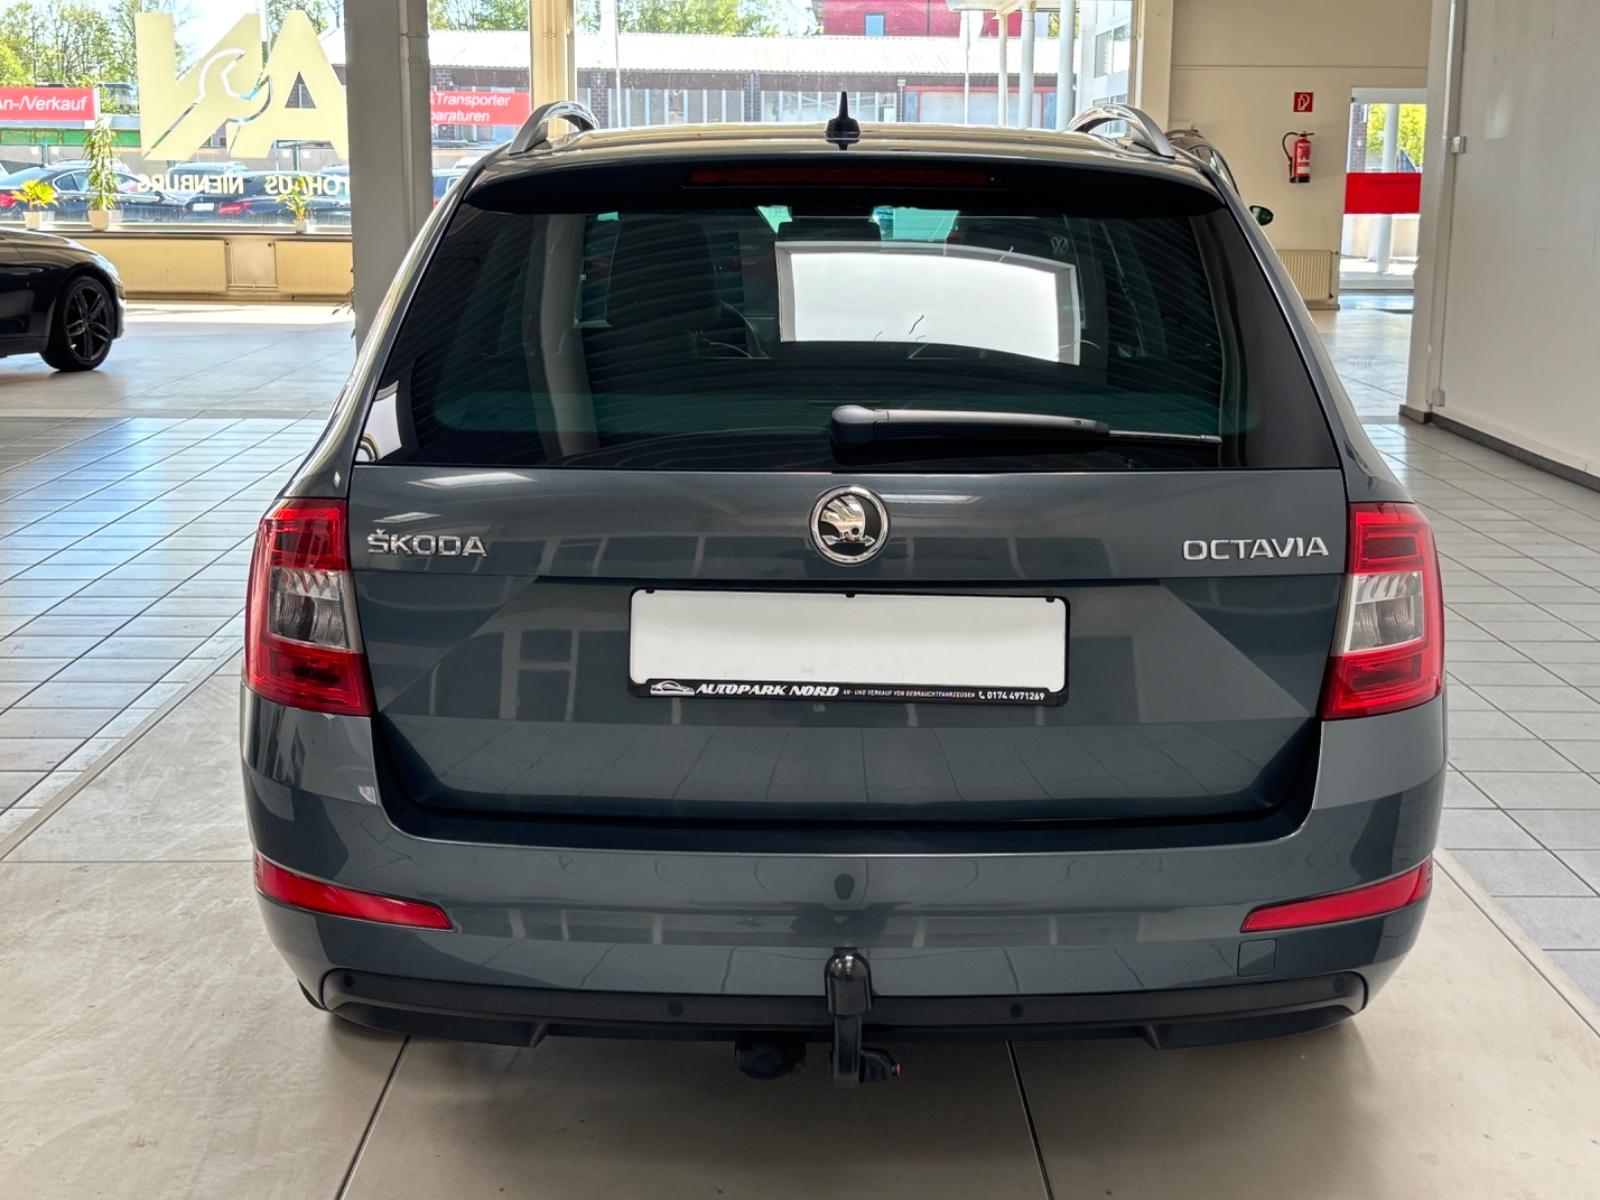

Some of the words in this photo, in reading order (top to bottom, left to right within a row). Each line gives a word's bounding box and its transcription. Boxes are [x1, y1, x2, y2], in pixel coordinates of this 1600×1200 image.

[436, 92, 511, 108] Transporter
[367, 528, 487, 557] ŠKODA
[1183, 536, 1329, 560] OCTAVIA
[696, 683, 787, 696] AUTOPARK
[789, 684, 840, 697] NORD
[987, 690, 1007, 700] 0174
[1009, 691, 1045, 701] 4971269
